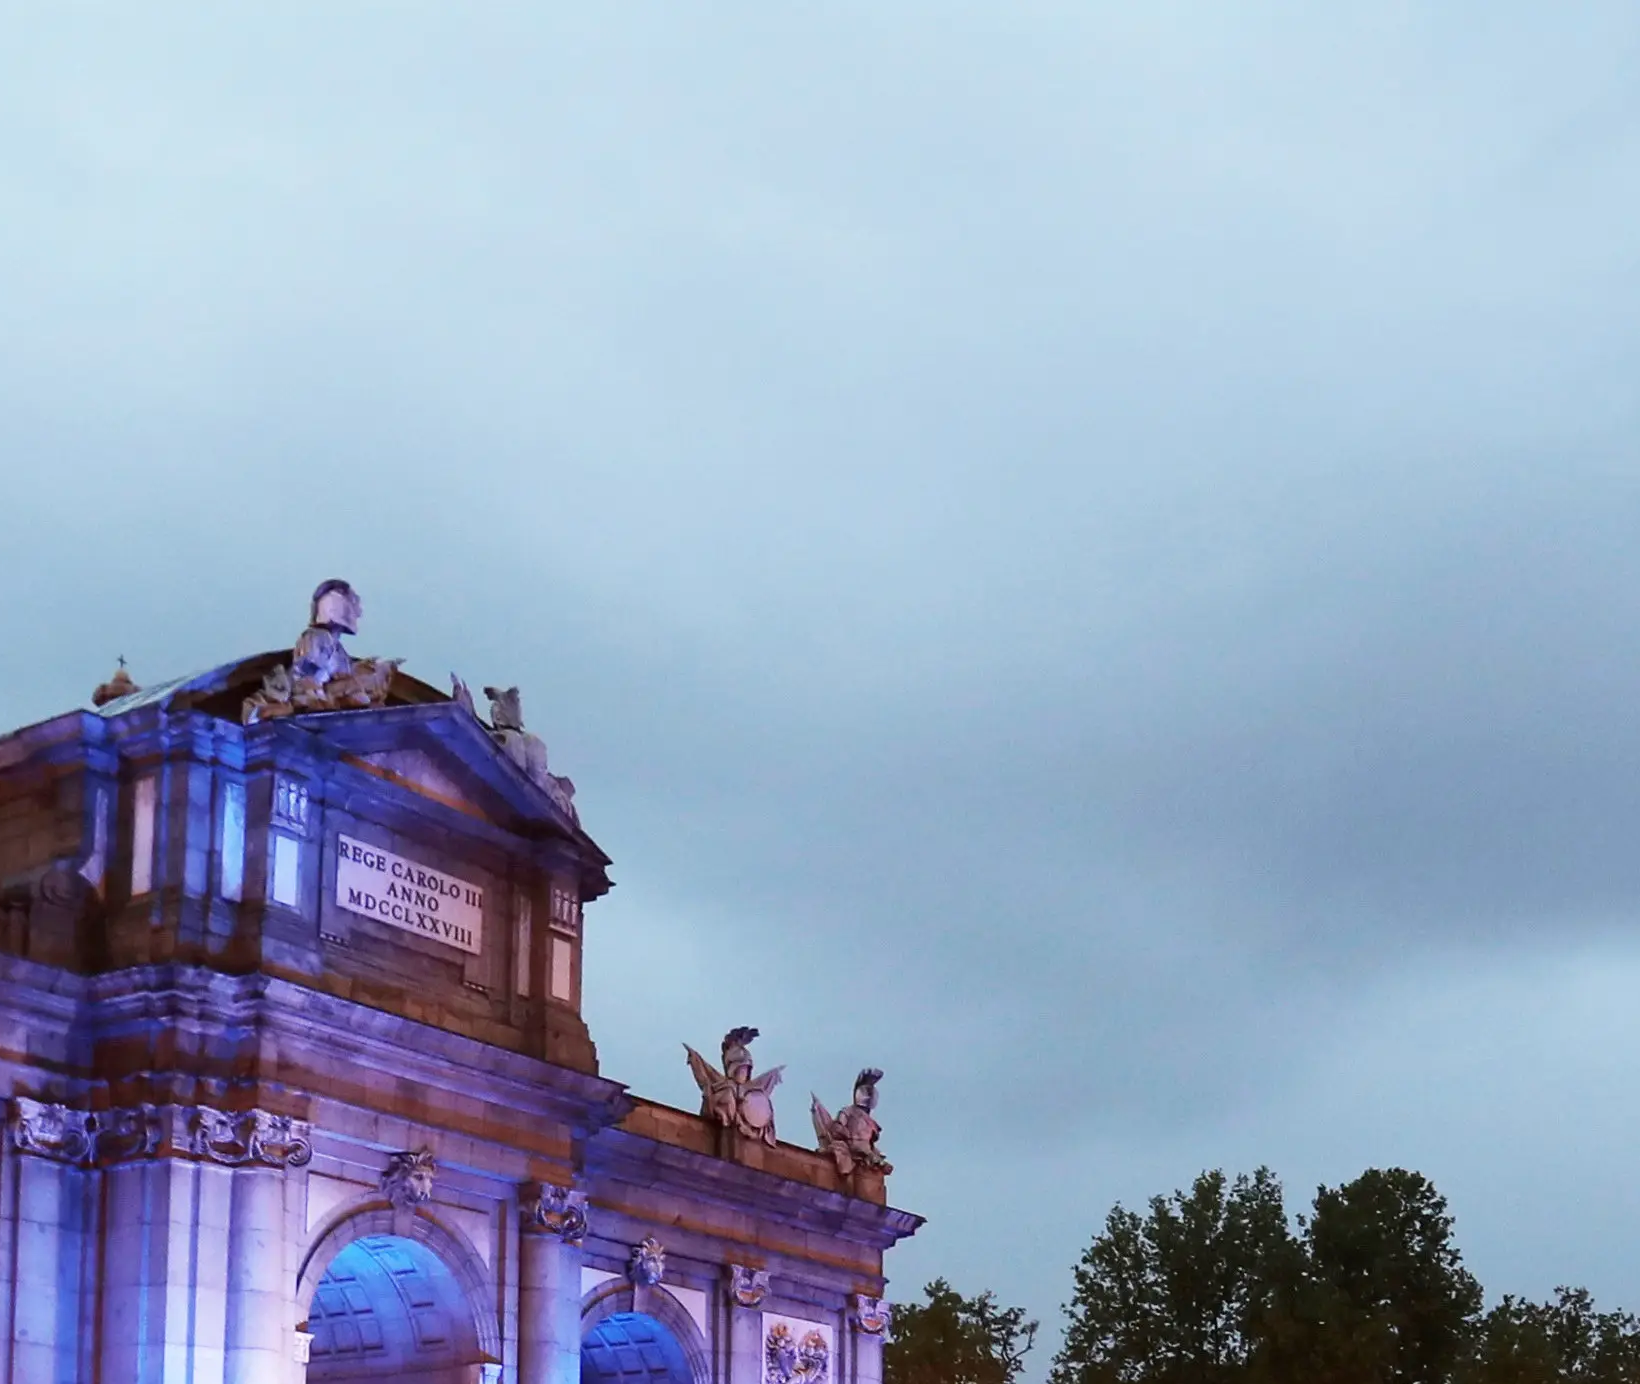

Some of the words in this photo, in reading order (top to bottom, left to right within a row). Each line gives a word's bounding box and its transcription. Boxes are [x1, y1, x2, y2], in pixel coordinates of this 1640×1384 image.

[338, 841, 386, 872] REGE
[391, 862, 460, 899] CAROLO
[465, 890, 483, 909] III
[386, 882, 439, 912] ANNO
[348, 887, 473, 946] MDCCLXXVIII
